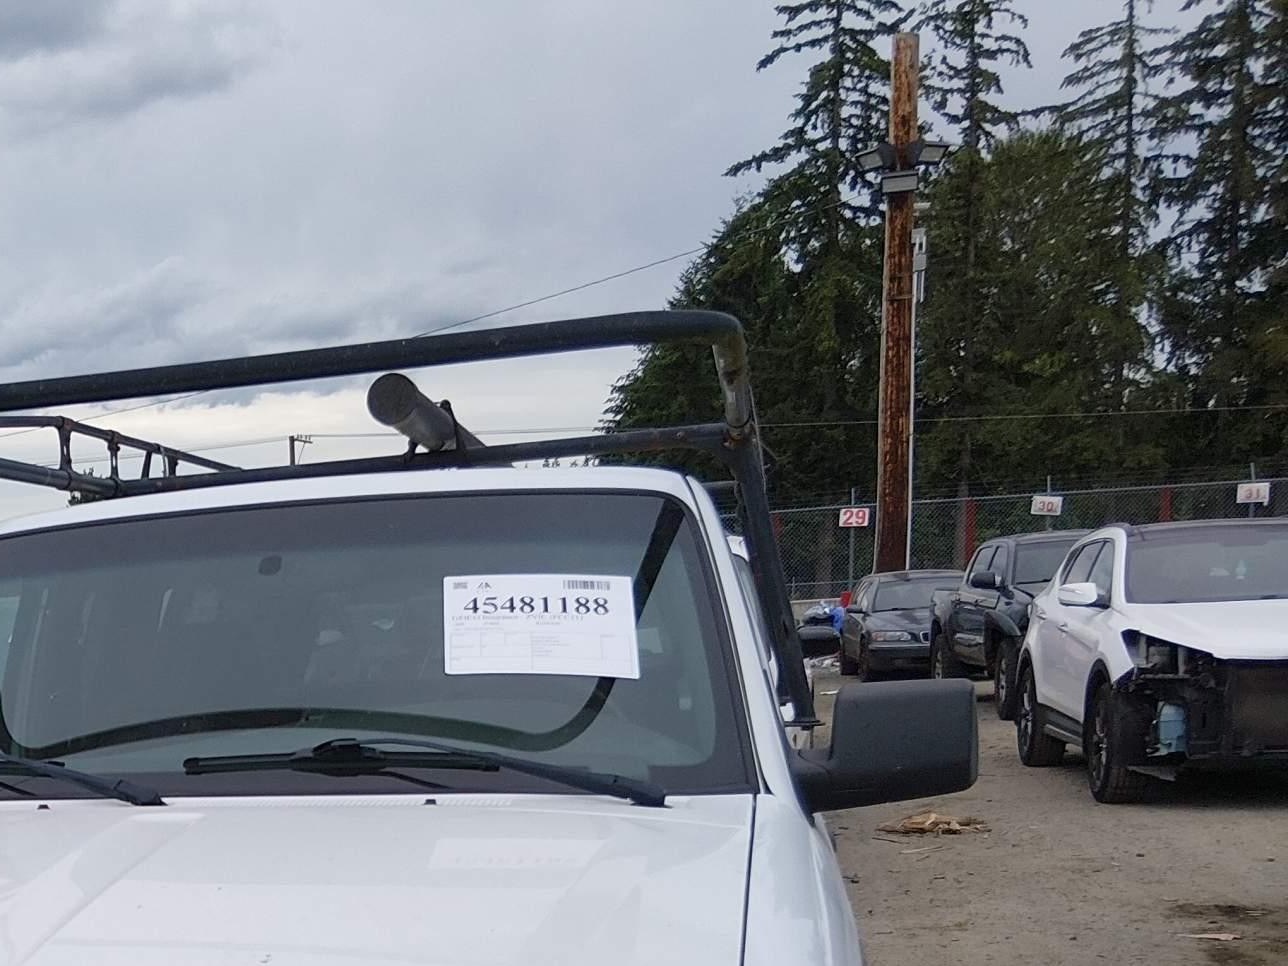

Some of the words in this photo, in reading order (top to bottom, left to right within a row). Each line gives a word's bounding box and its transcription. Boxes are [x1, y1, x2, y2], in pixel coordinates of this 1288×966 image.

[1038, 500, 1055, 512] 30
[843, 510, 867, 525] 29
[463, 595, 610, 616] 45481188
